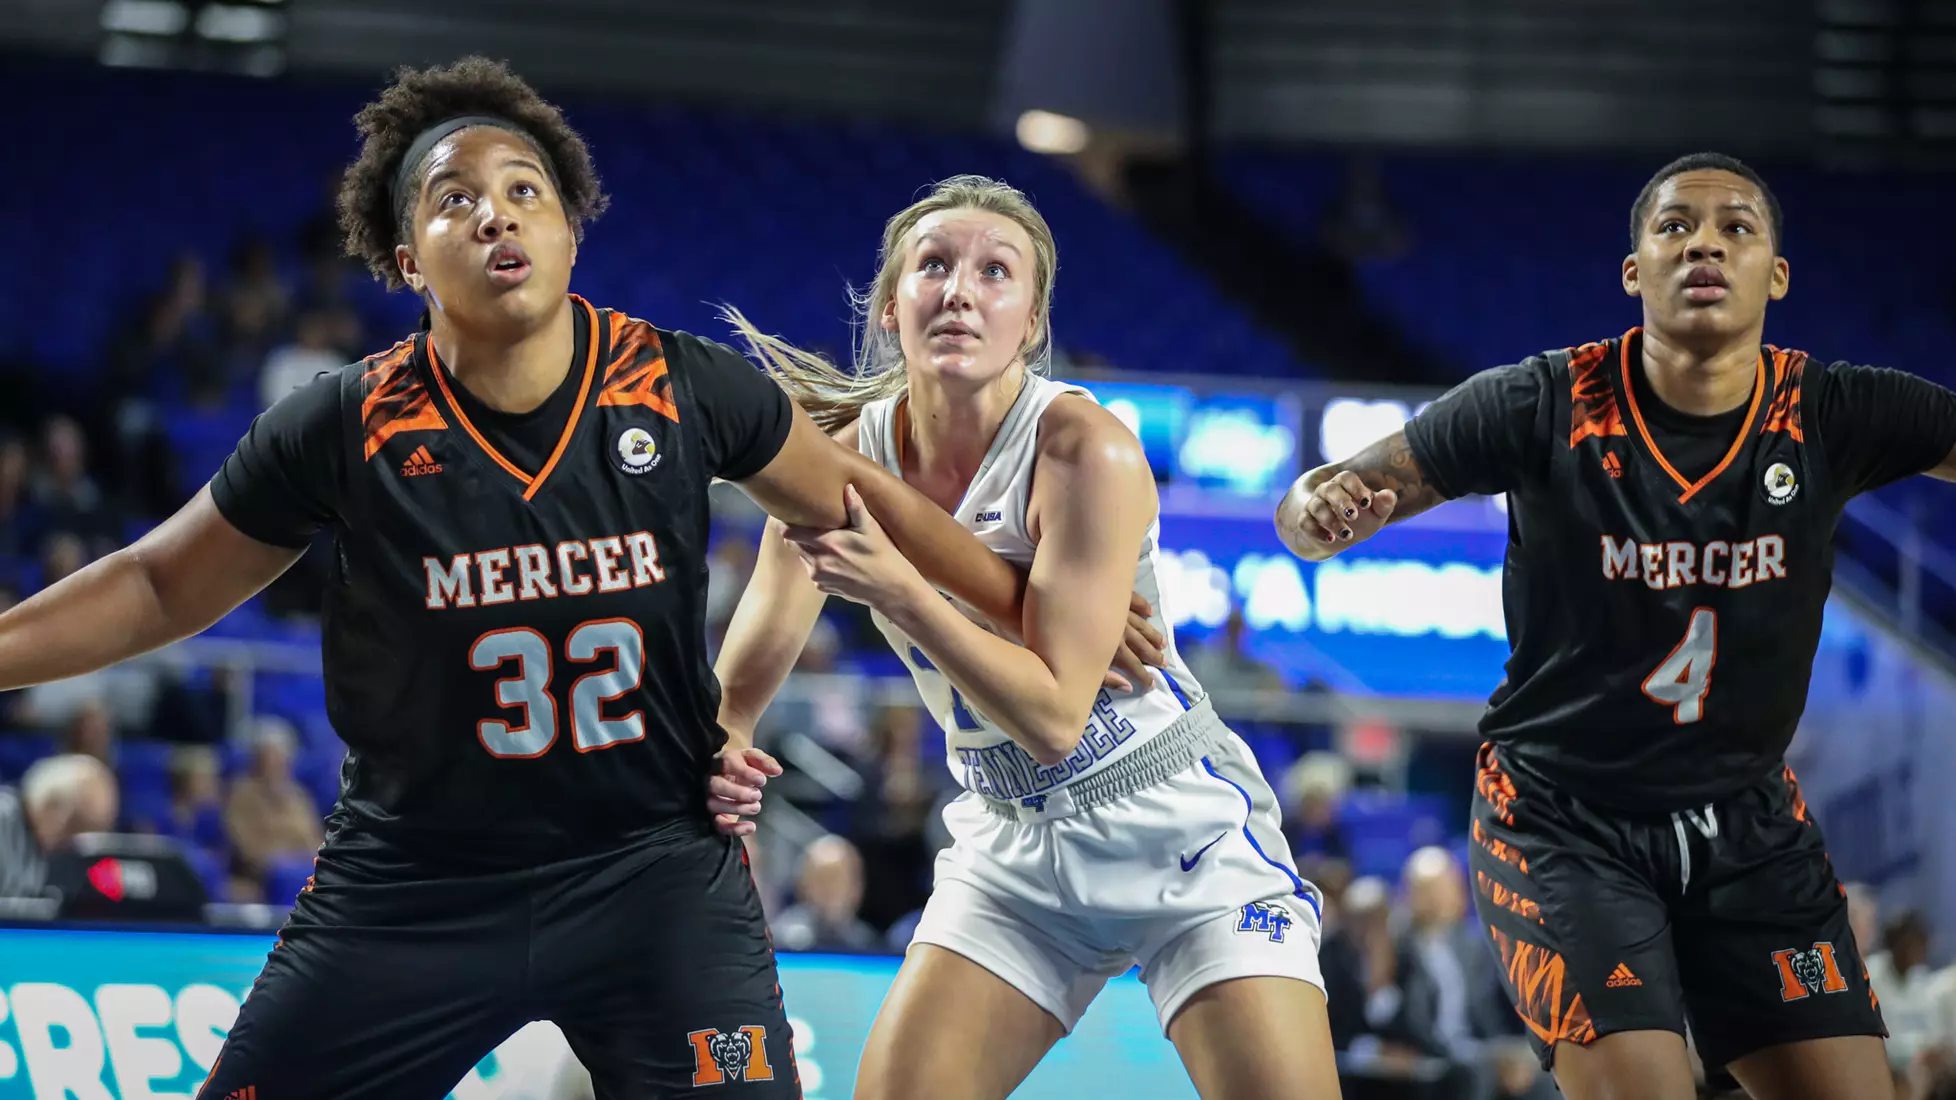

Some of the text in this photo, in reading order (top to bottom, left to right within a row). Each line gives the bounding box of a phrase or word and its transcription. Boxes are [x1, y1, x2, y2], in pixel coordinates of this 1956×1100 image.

[401, 463, 443, 477] adidas
[622, 464, 643, 474] United
[651, 454, 661, 467] One
[422, 530, 666, 610] MERCER
[1600, 534, 1787, 590] MERCER
[468, 616, 646, 760] 32
[1640, 606, 1718, 725] 4
[1237, 901, 1291, 944] MT
[1606, 977, 1642, 988] adidas
